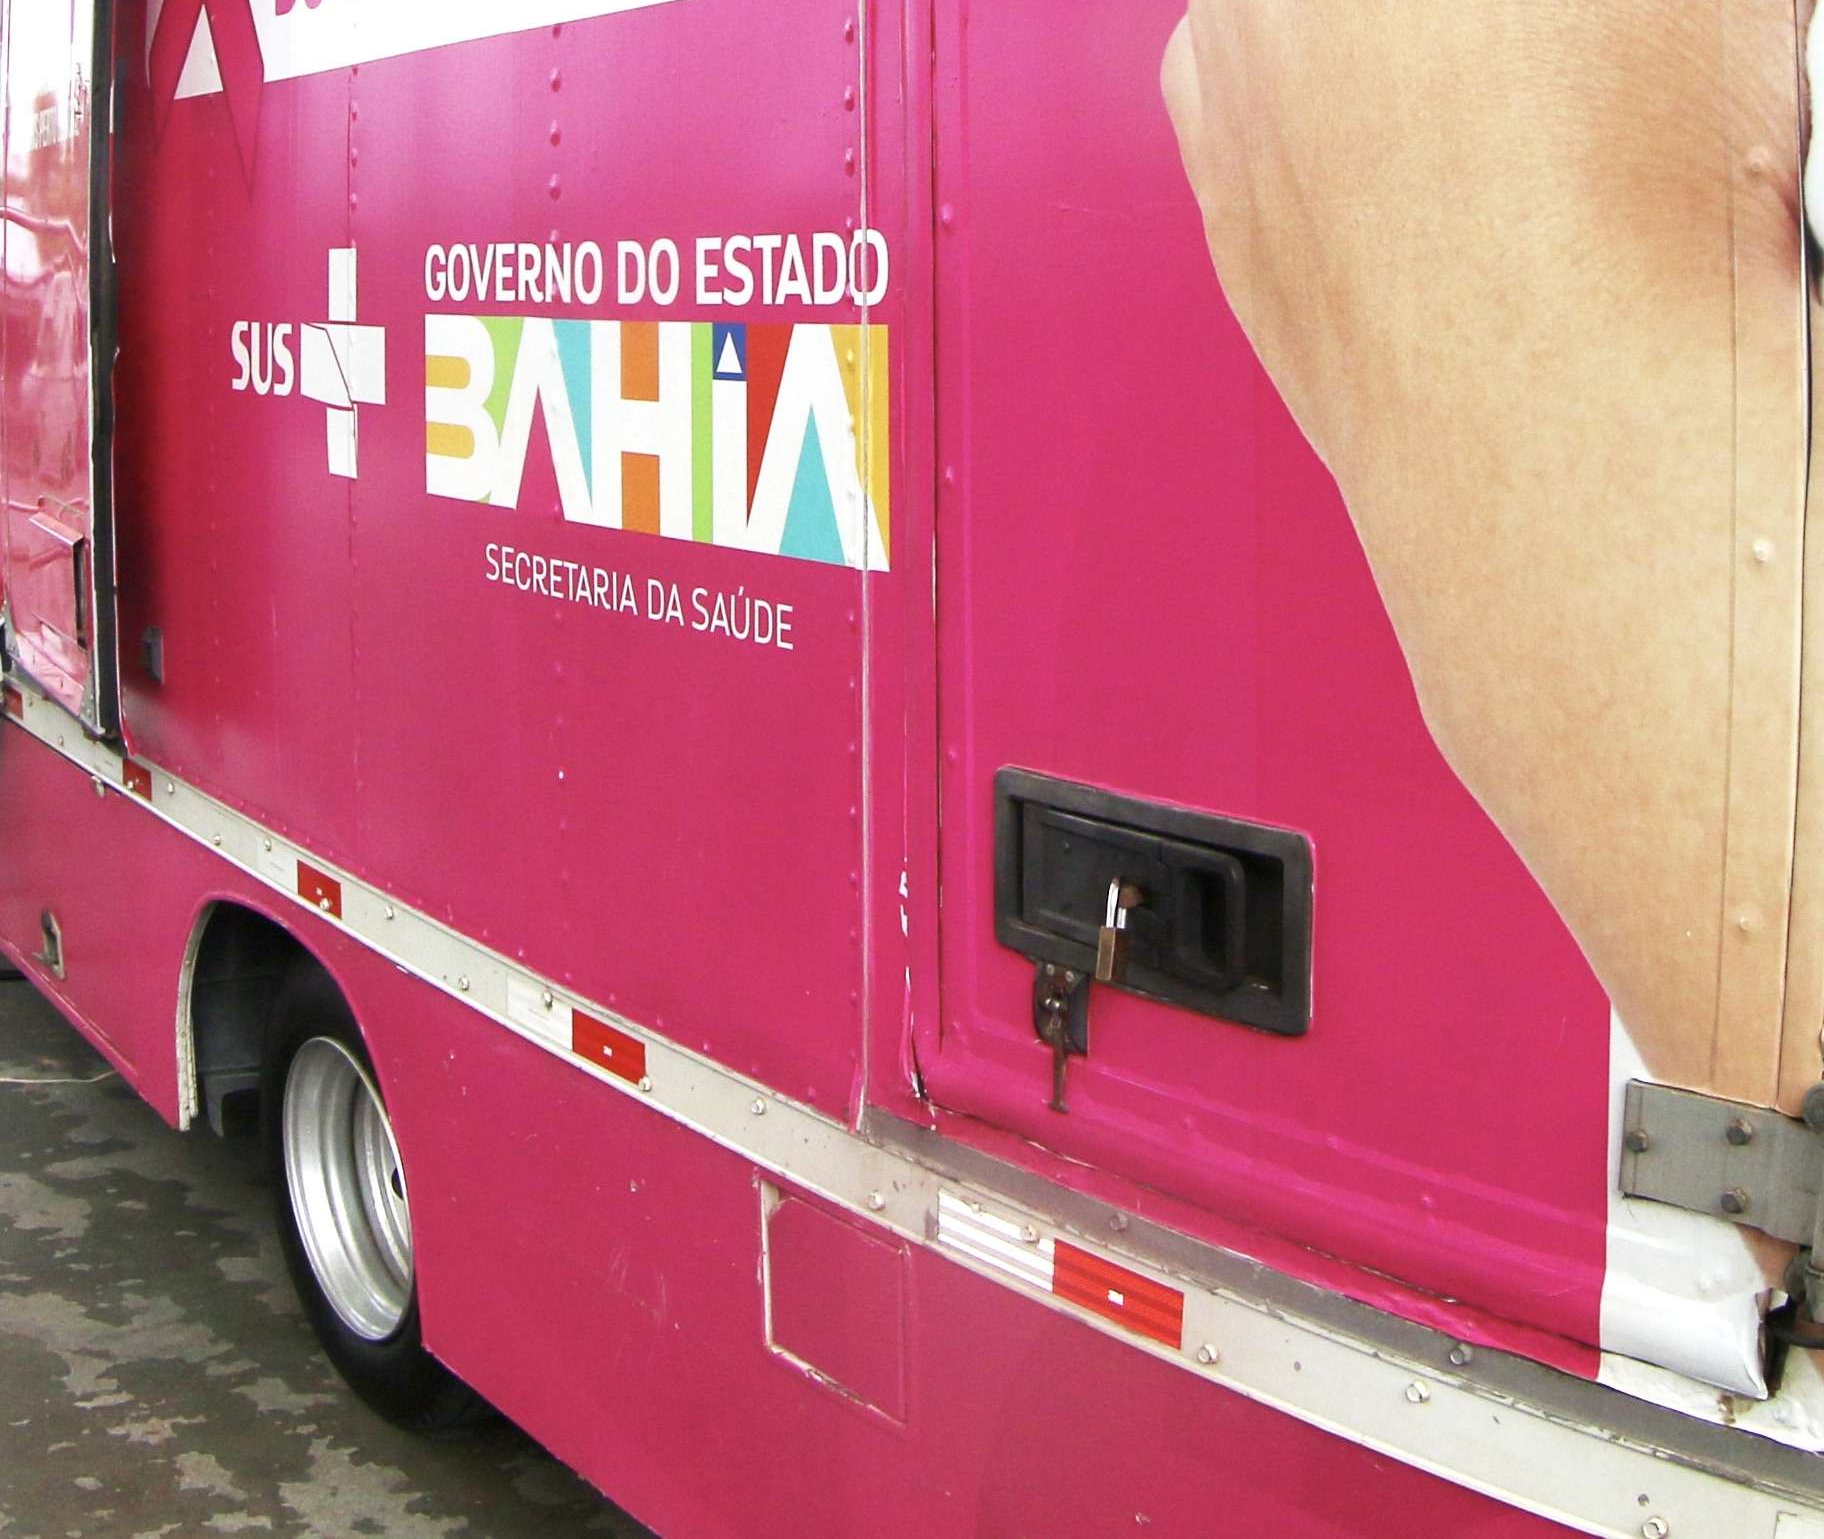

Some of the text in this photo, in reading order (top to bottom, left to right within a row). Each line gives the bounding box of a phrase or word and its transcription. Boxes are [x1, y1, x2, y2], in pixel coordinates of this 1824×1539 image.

[424, 228, 889, 307] GOVERNO DO ESTADO
[231, 320, 296, 396] SUS
[424, 313, 890, 573] BAHIA
[485, 543, 794, 651] SECRETARIA DA SAÚDE
